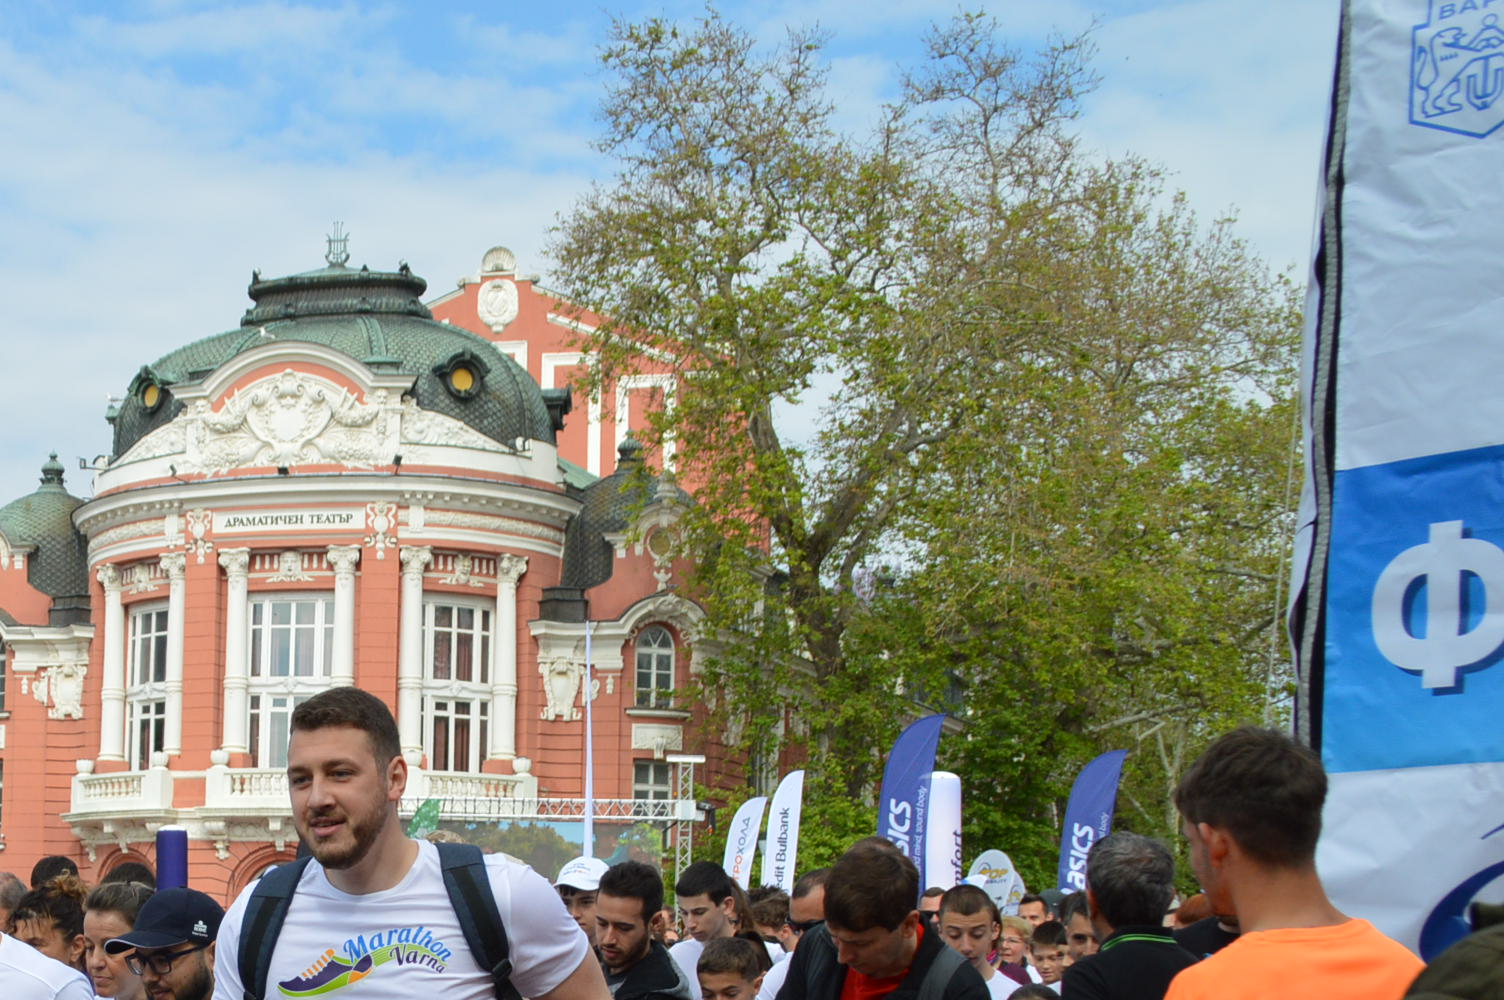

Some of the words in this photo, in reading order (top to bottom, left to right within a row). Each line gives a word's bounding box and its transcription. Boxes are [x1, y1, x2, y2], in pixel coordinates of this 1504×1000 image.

[224, 514, 304, 528] ДРАМАТИЧЕН
[309, 513, 354, 524] ТЕАТЪР
[776, 807, 790, 862] Bulbank
[343, 926, 453, 963] Marathon
[389, 944, 446, 974] Varna
